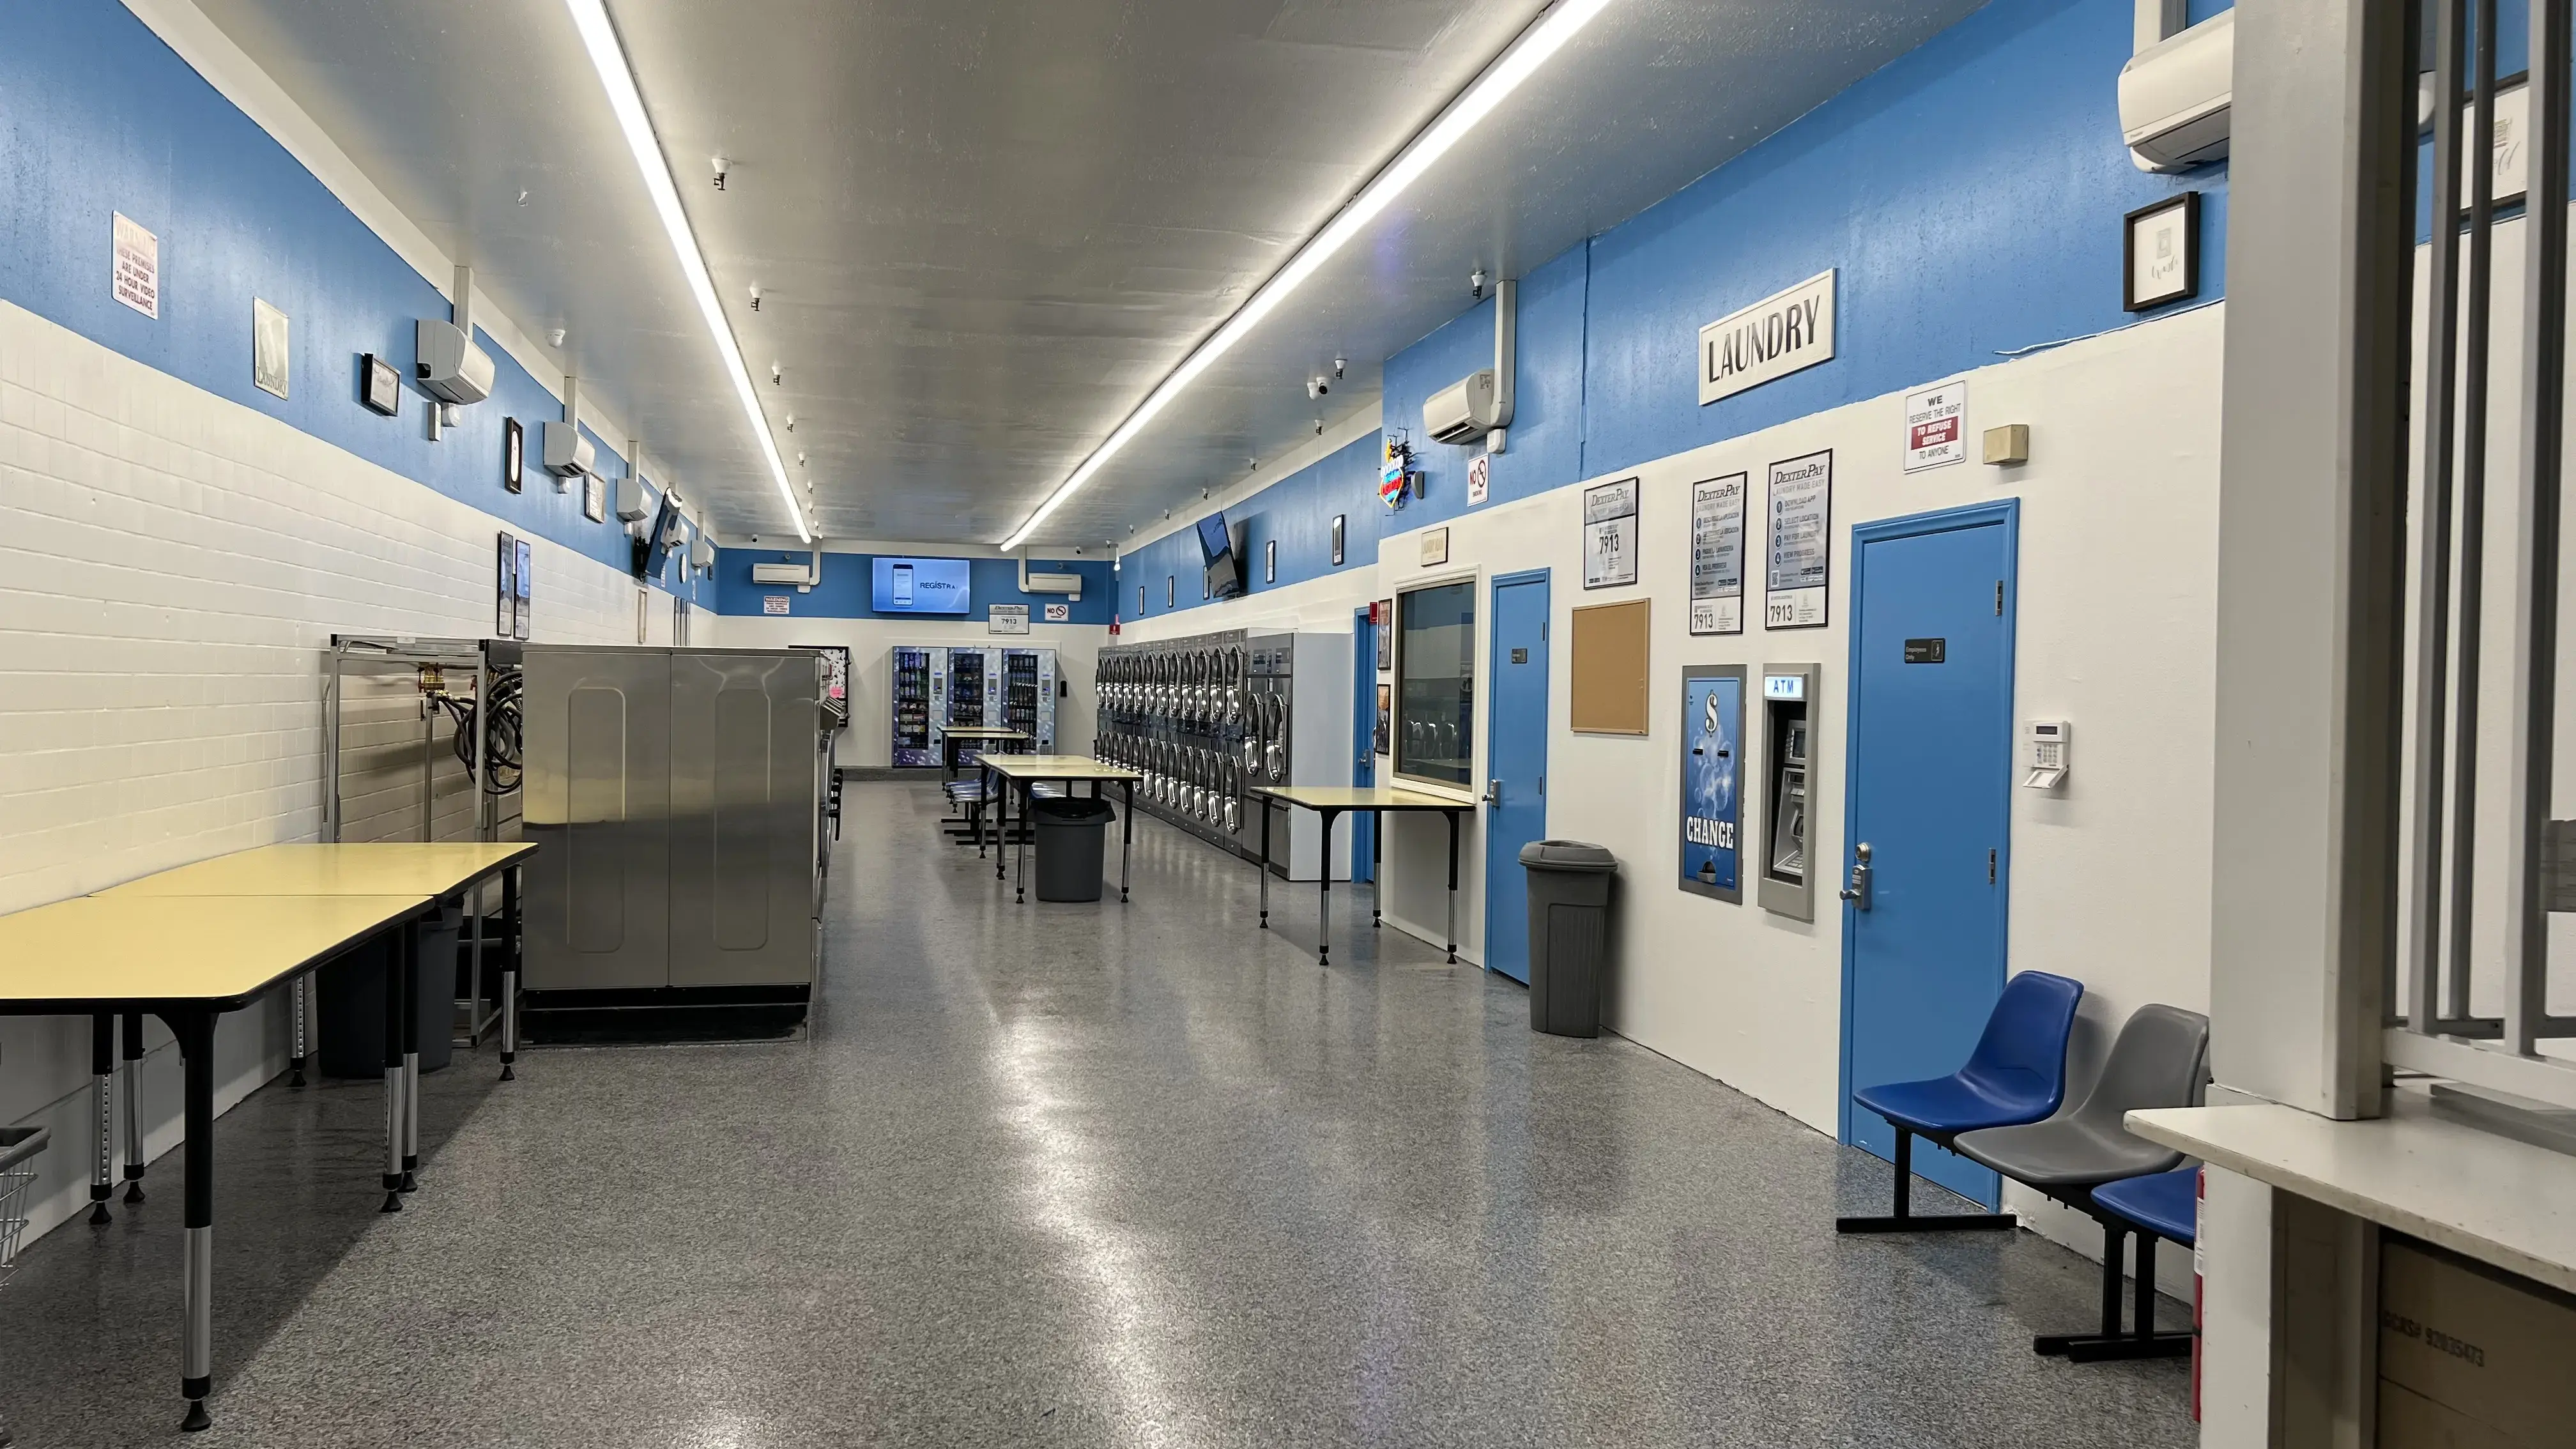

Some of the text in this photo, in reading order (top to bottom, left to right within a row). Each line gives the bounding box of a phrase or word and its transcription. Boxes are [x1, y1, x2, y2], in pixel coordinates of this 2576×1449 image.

[117, 247, 155, 274] THESE PREMISES
[122, 261, 149, 284] ARE UNDER
[116, 270, 155, 299] 24 HOUR VIDEO
[118, 285, 153, 311] SURVEILLANCE
[1708, 295, 1820, 384] LAUNDRY
[256, 365, 288, 395] LAUNDRY
[1928, 395, 1943, 407] WE
[1909, 403, 1961, 424] RESERVE THE RIGHT
[1917, 419, 1952, 436] TO REFUSE
[1922, 432, 1947, 446] SERVICE
[1919, 450, 1926, 459] TO
[1928, 445, 1949, 458] ANYONE
[1470, 470, 1476, 486] NO
[1773, 479, 1825, 496] LAUNDRY MADE EASY
[1799, 513, 1819, 522] LOCATION
[1599, 533, 1619, 555] 7913
[1793, 548, 1815, 558] PROGRESS
[1694, 613, 1713, 629] 7913
[1770, 604, 1793, 622] 7913
[1773, 680, 1794, 694] ATM
[1705, 689, 1719, 738] $
[1686, 816, 1734, 850] CHANGE
